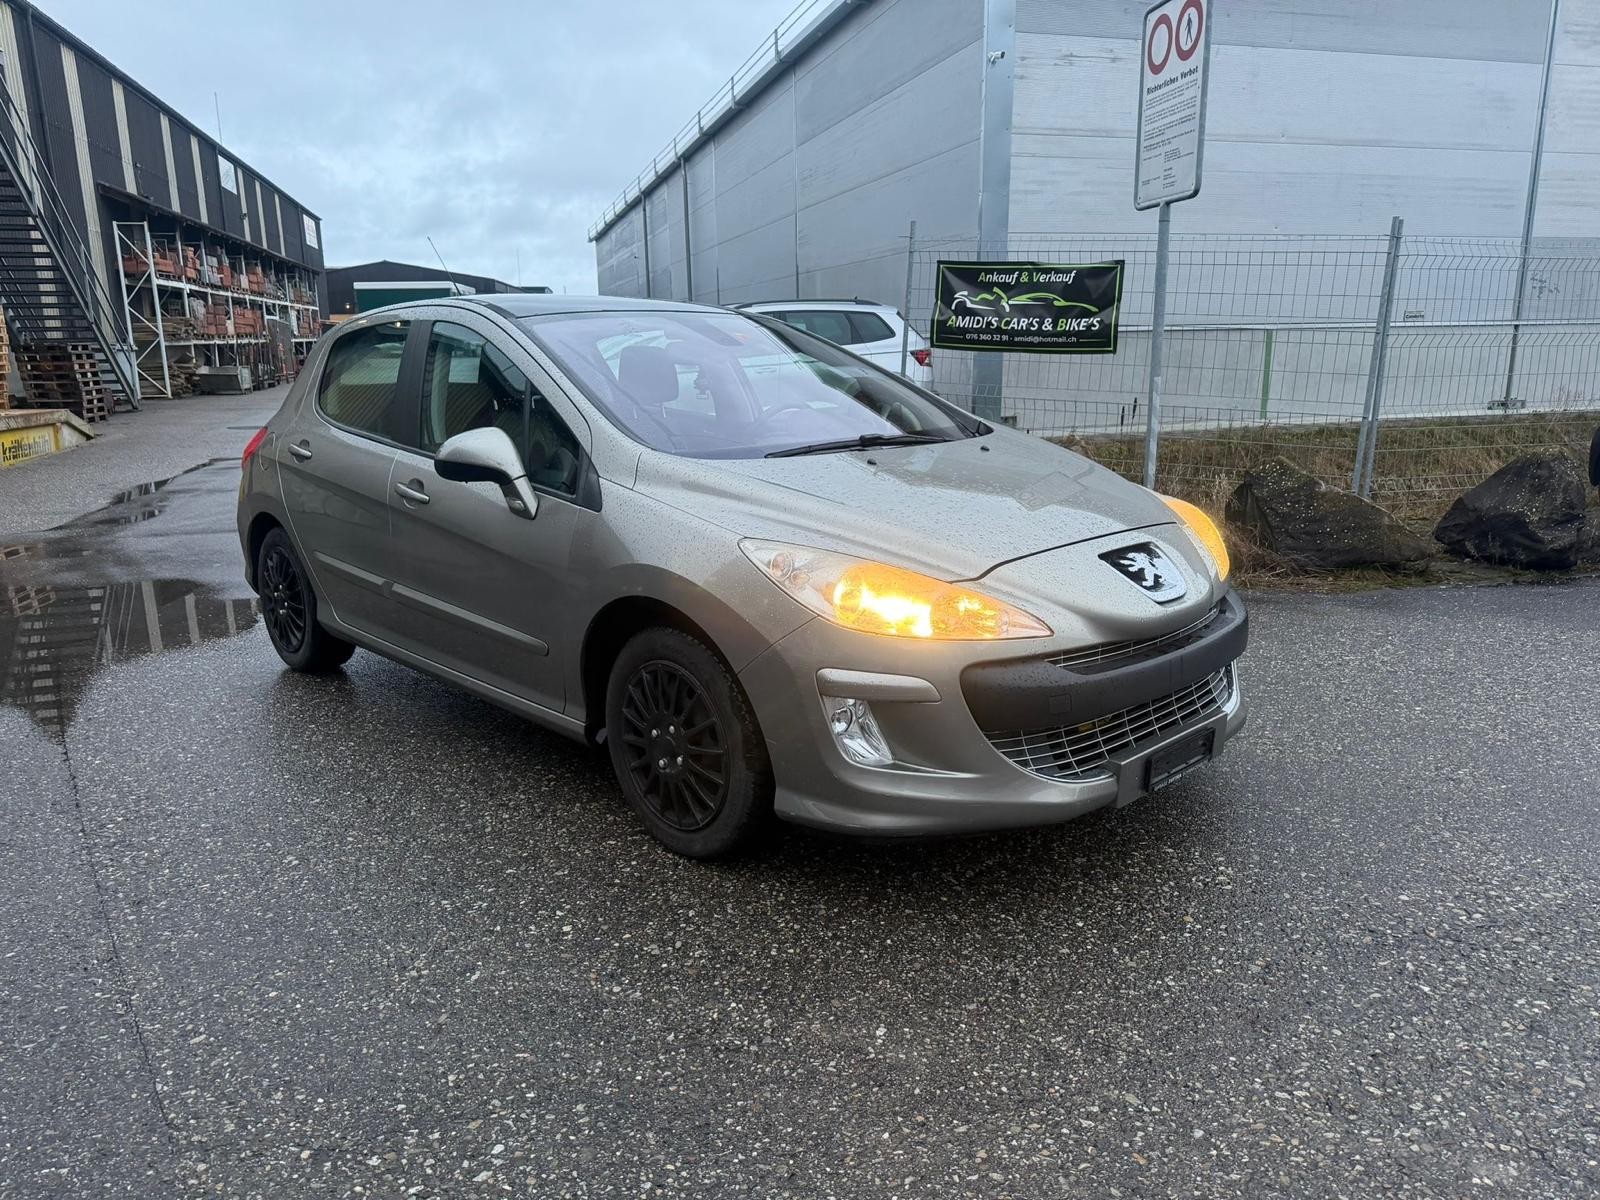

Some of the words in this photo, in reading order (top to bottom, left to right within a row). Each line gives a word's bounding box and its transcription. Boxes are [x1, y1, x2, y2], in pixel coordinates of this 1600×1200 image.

[1146, 76, 1179, 96] Richterliches
[1180, 65, 1199, 80] Verbot
[978, 271, 1019, 285] Ankauf
[1020, 271, 1029, 283] &
[1033, 270, 1077, 284] Verkauf
[946, 315, 998, 329] AMIDI'S
[1000, 317, 1040, 331] CAR'S
[1042, 319, 1053, 331] &
[1056, 317, 1100, 331] BIKE'S
[1014, 335, 1077, 344] amidi@hotmail.ch
